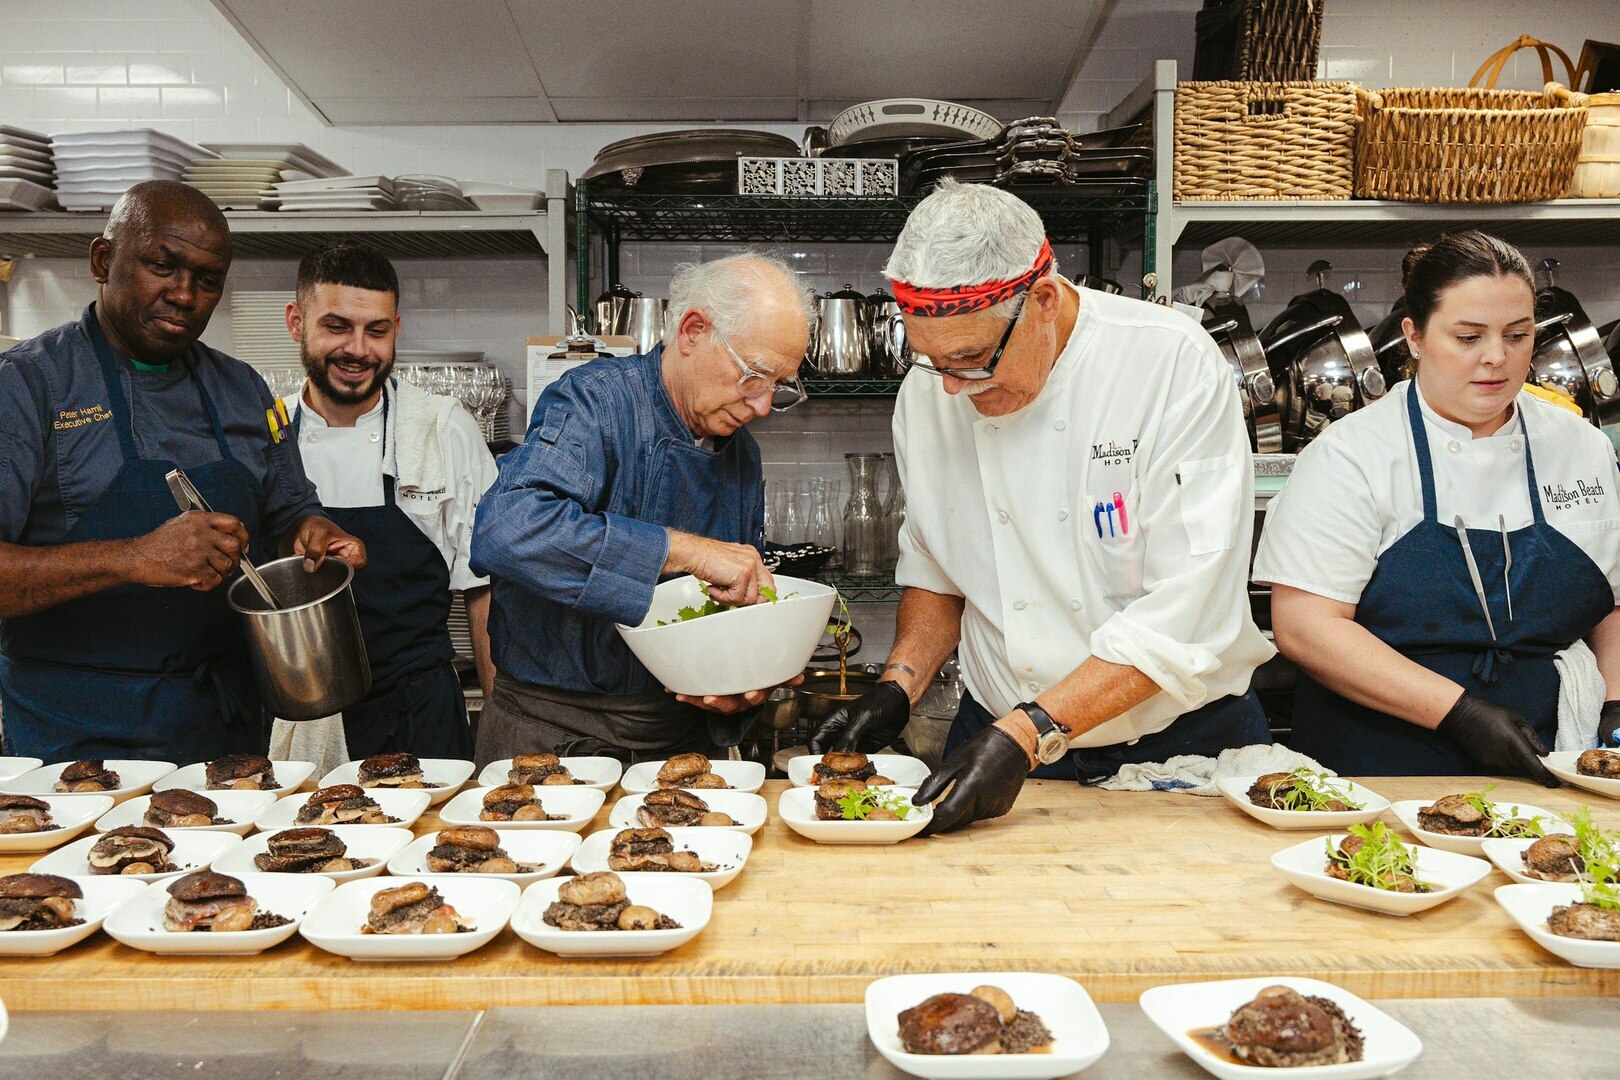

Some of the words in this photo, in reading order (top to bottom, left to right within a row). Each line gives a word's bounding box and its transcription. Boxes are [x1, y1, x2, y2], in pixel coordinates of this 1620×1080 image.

[54, 416, 92, 430] Executive
[93, 409, 113, 422] Chef
[1092, 442, 1131, 460] Madison
[1104, 457, 1131, 467] HOT
[1543, 483, 1580, 503] Madison
[1576, 477, 1605, 497] Beach
[1556, 497, 1599, 511] HOTEL
